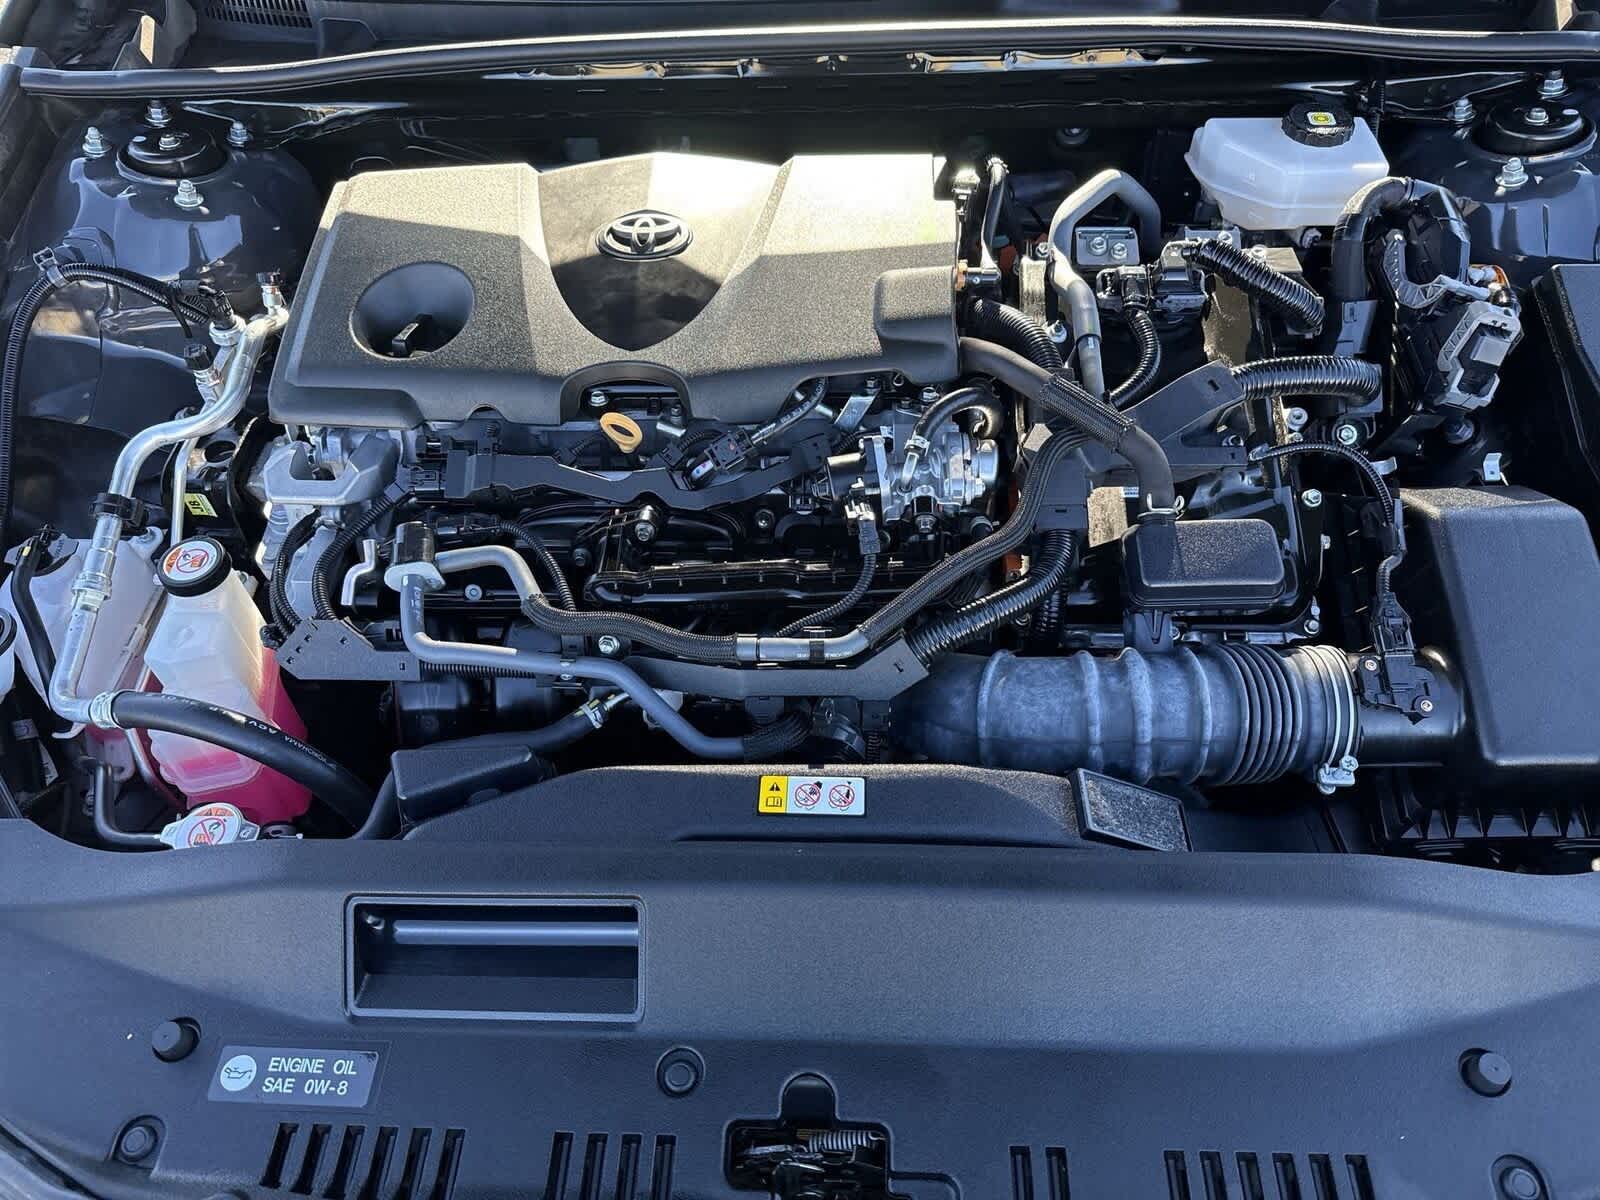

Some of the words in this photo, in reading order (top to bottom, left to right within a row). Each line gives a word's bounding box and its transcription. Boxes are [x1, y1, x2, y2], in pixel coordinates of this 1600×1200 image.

[268, 1057, 325, 1073] ENGINE
[333, 1060, 357, 1075] OIL
[262, 1077, 295, 1093] SAE
[304, 1079, 348, 1095] 0W-8
